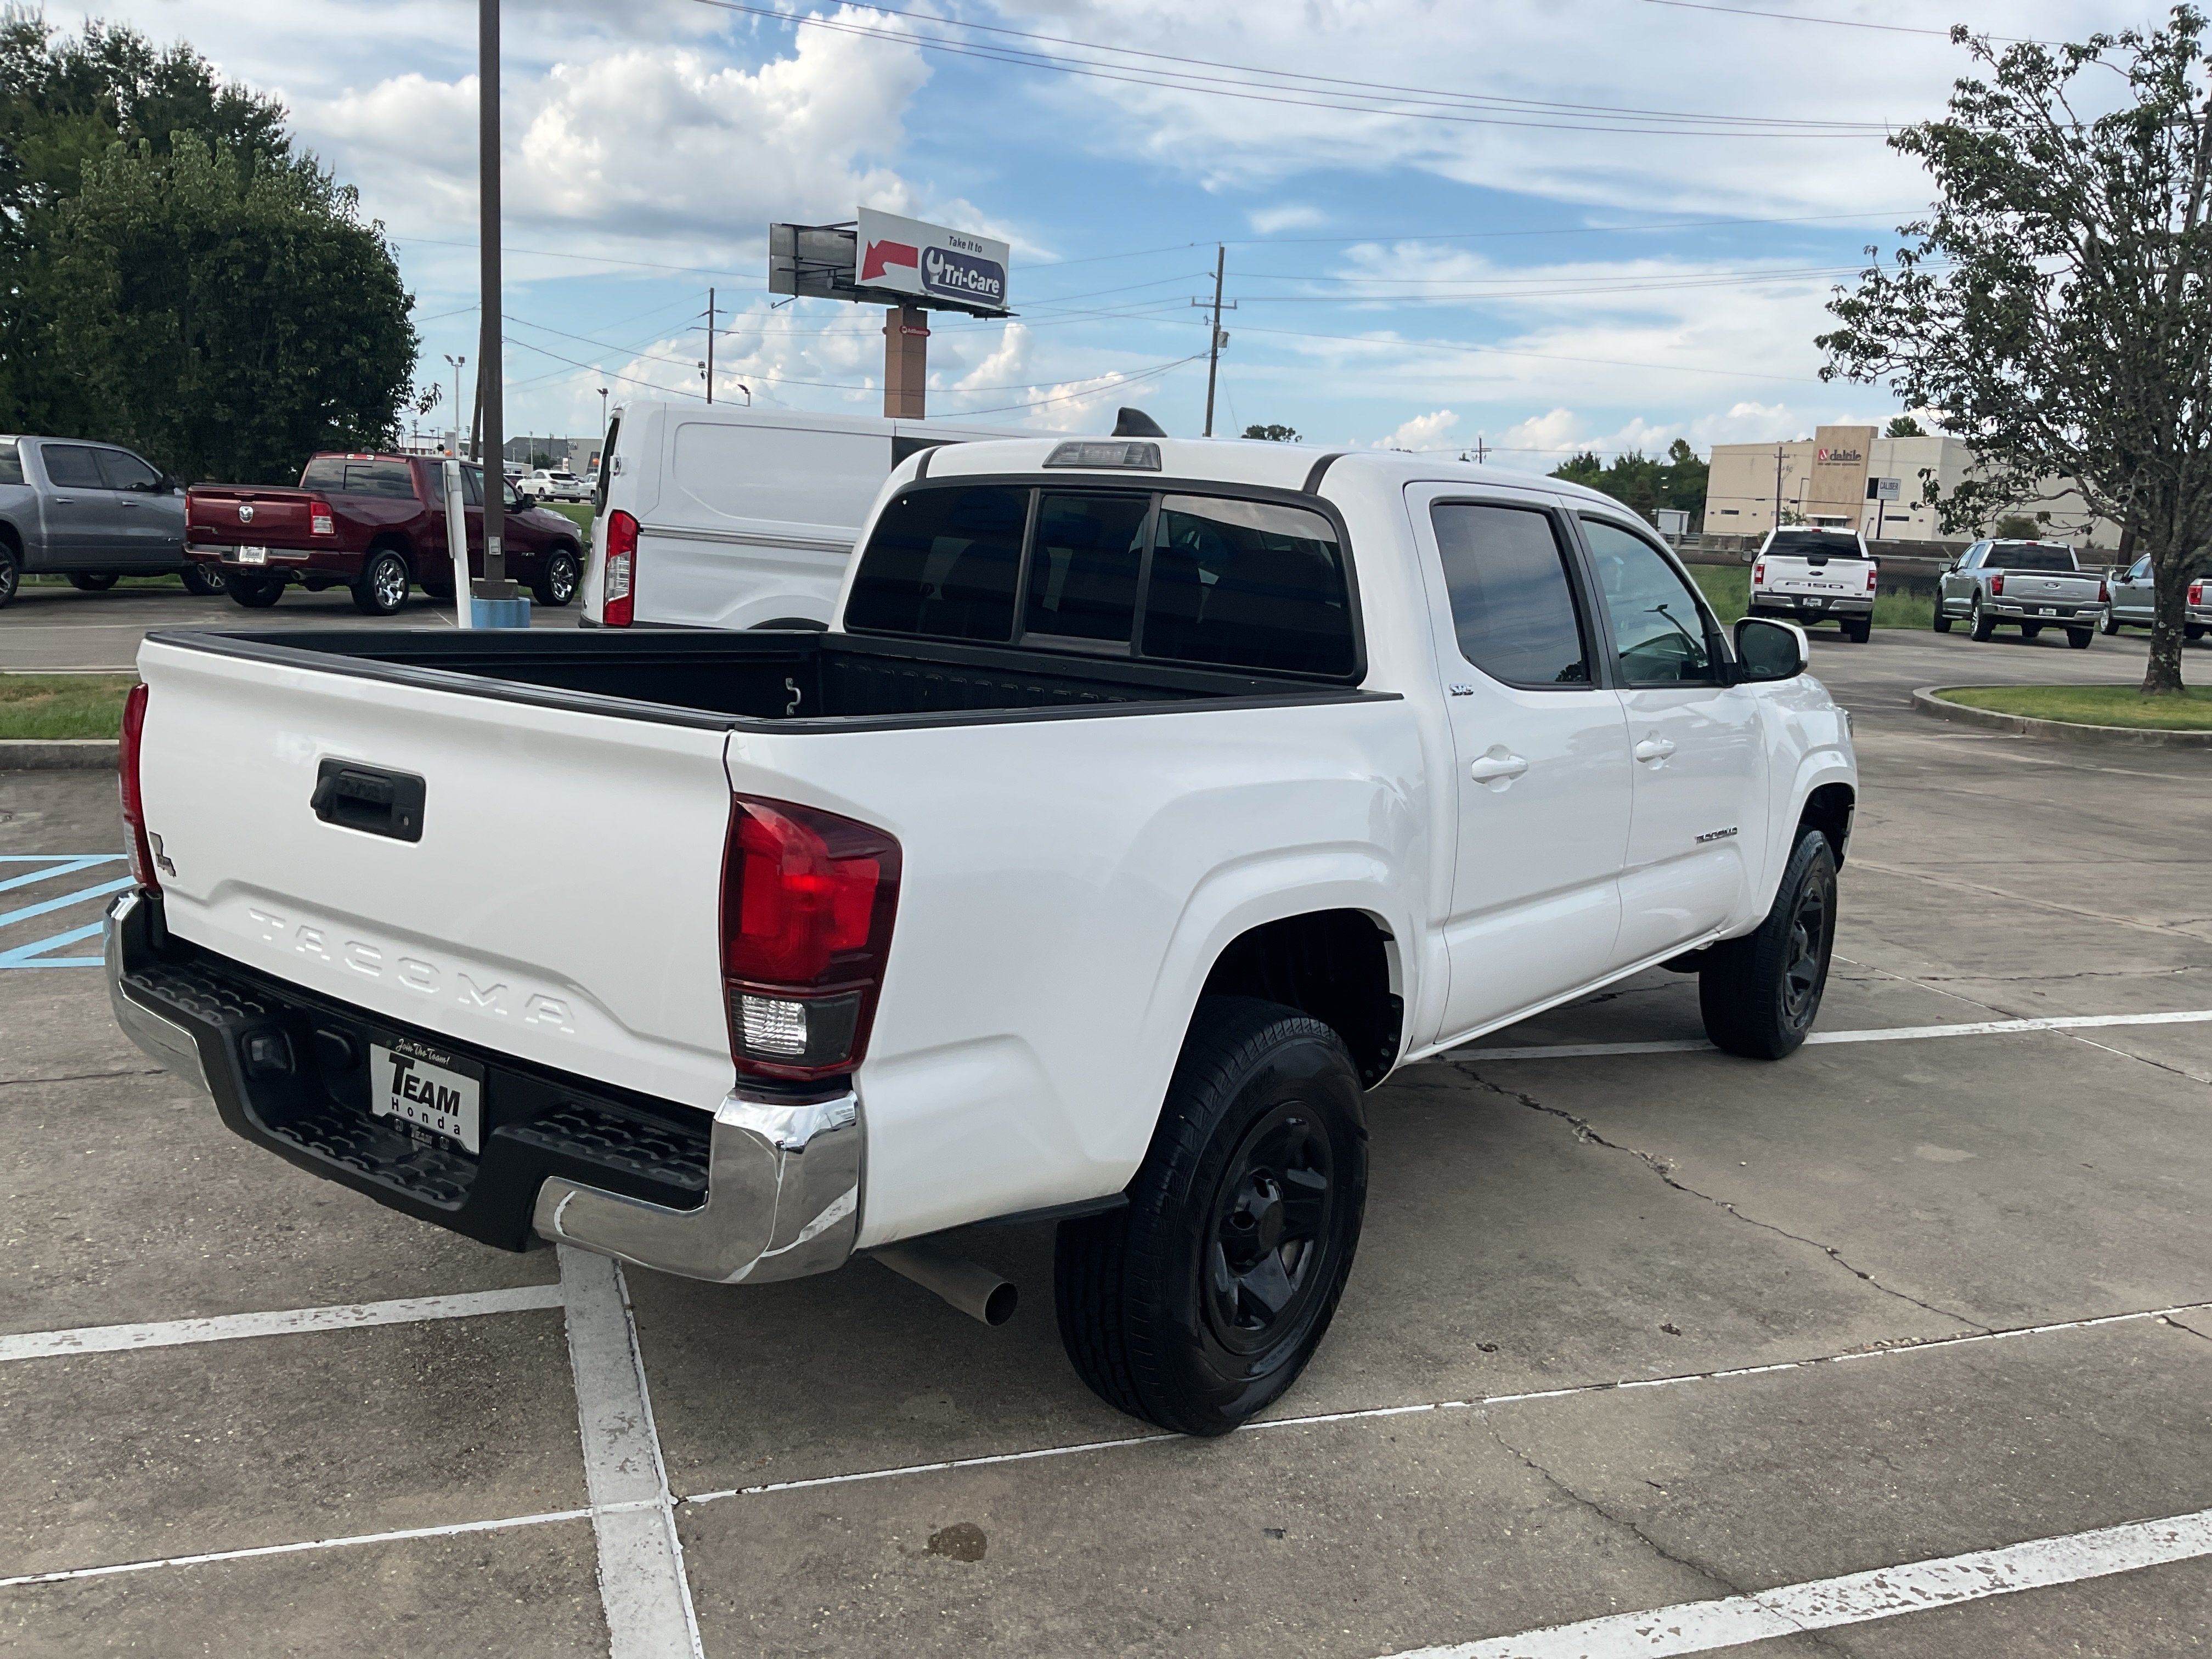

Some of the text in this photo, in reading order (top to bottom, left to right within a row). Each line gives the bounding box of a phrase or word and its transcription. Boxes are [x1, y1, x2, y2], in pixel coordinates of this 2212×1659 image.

[949, 236, 966, 249] Take
[974, 243, 983, 253] to
[944, 264, 1000, 294] Tri-Care
[1880, 481, 1898, 490] CALIBER
[249, 907, 575, 1034] TACOMA
[396, 1039, 450, 1065] Join The Team!
[388, 1052, 461, 1117] TEAM
[391, 1097, 460, 1136] Honda
